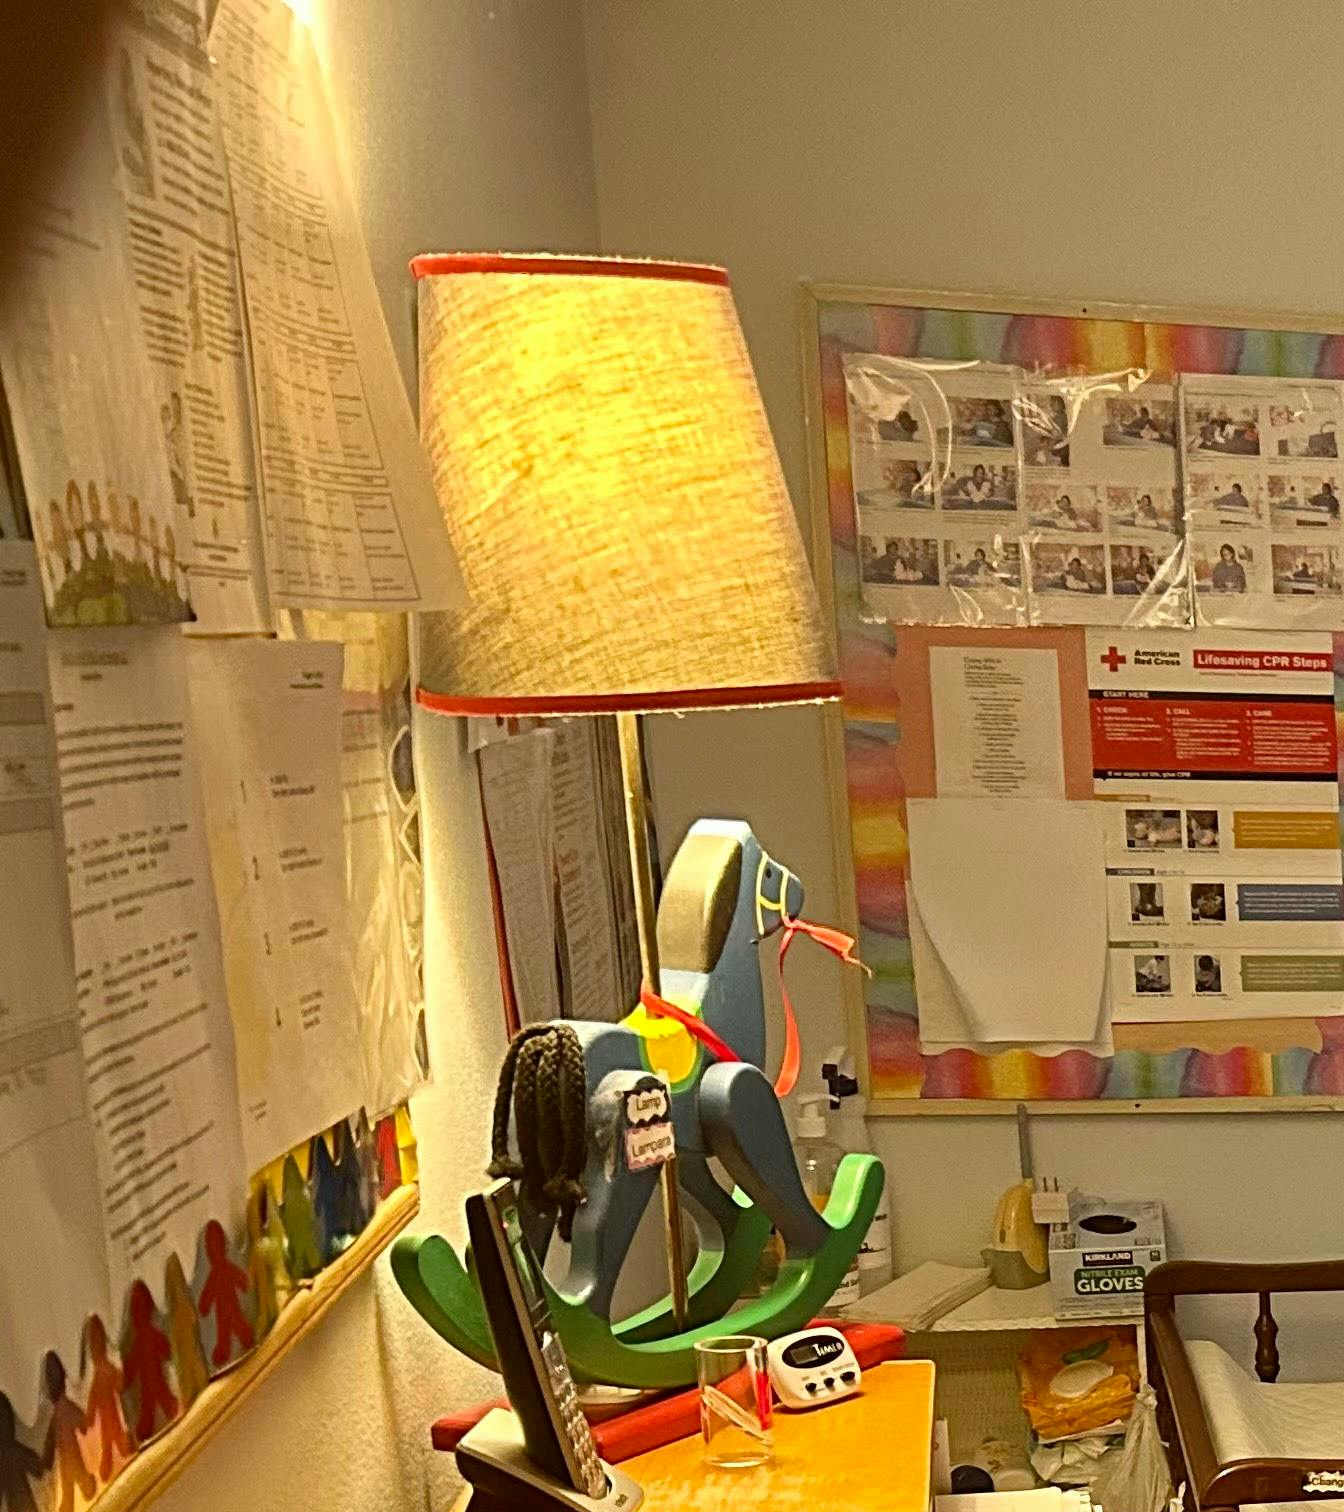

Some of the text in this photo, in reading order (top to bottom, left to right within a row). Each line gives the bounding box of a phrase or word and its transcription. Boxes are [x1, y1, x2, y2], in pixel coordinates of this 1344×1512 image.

[1134, 649, 1181, 659] American
[1134, 657, 1182, 667] Red Cross
[1197, 653, 1328, 669] Lifesaving CPR Steps
[636, 1096, 661, 1111] Lamp
[632, 1136, 671, 1157] Lampara
[1084, 1252, 1131, 1262] KIRKLAND
[1081, 1270, 1112, 1278] NITRILE
[1077, 1277, 1144, 1292] GLOVES
